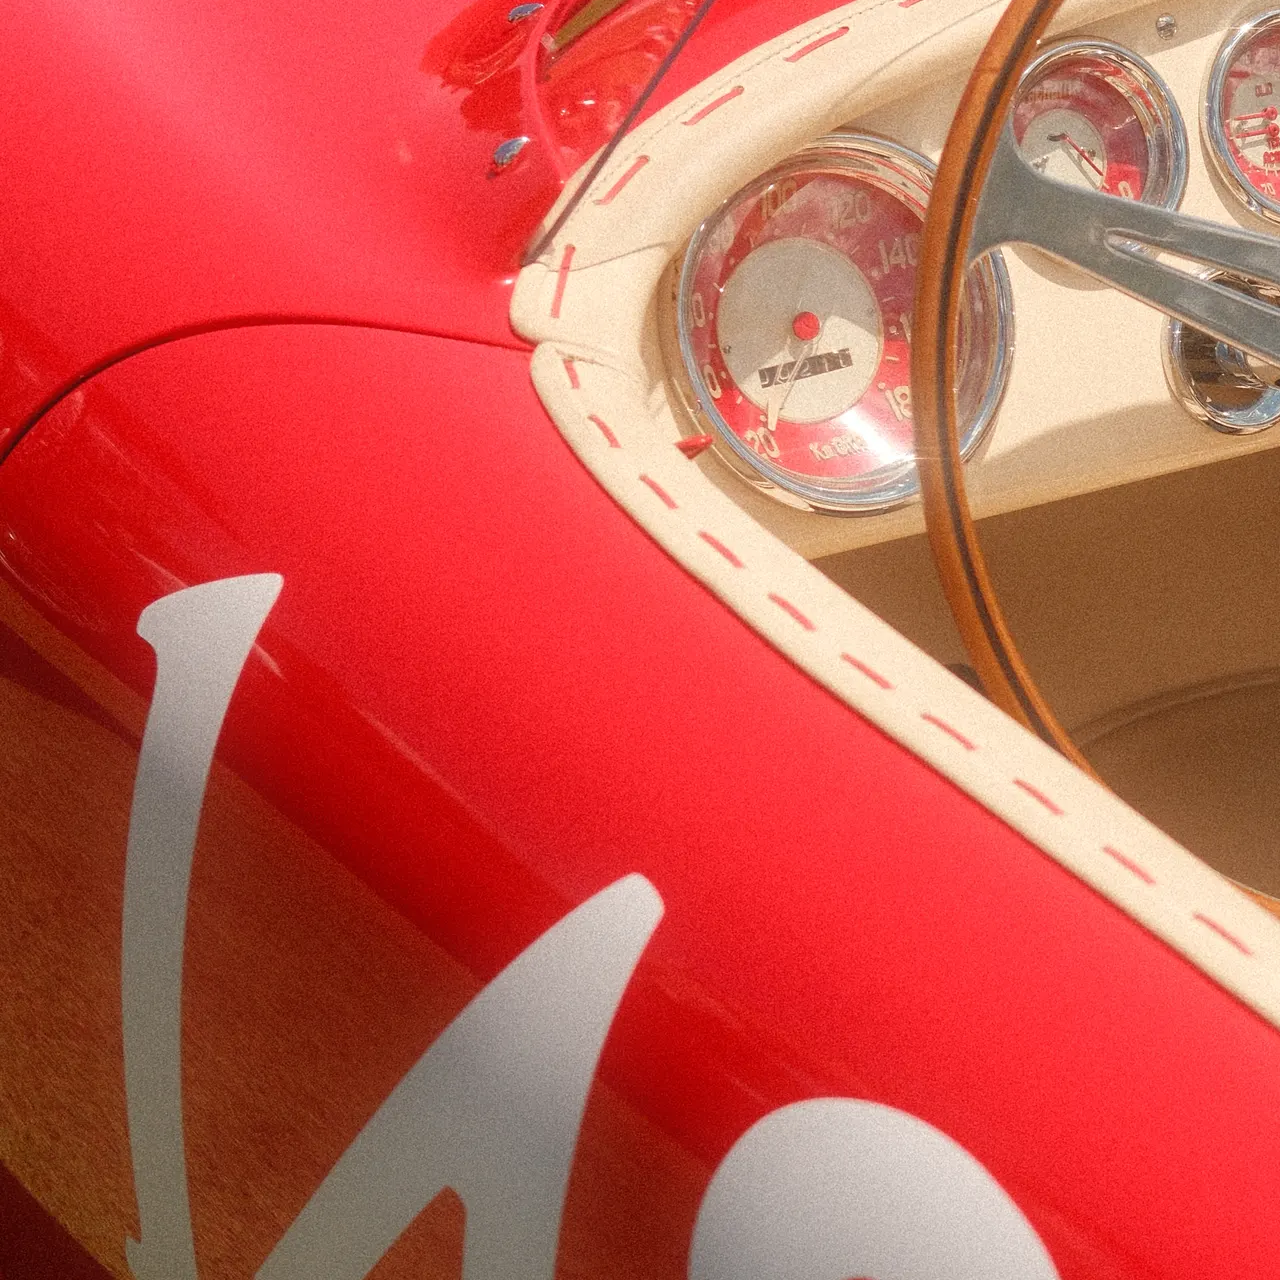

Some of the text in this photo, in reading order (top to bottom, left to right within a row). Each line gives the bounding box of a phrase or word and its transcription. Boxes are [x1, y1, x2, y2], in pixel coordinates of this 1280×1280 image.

[760, 180, 799, 220] 100
[1261, 182, 1276, 196] 70
[745, 426, 781, 459] 20
